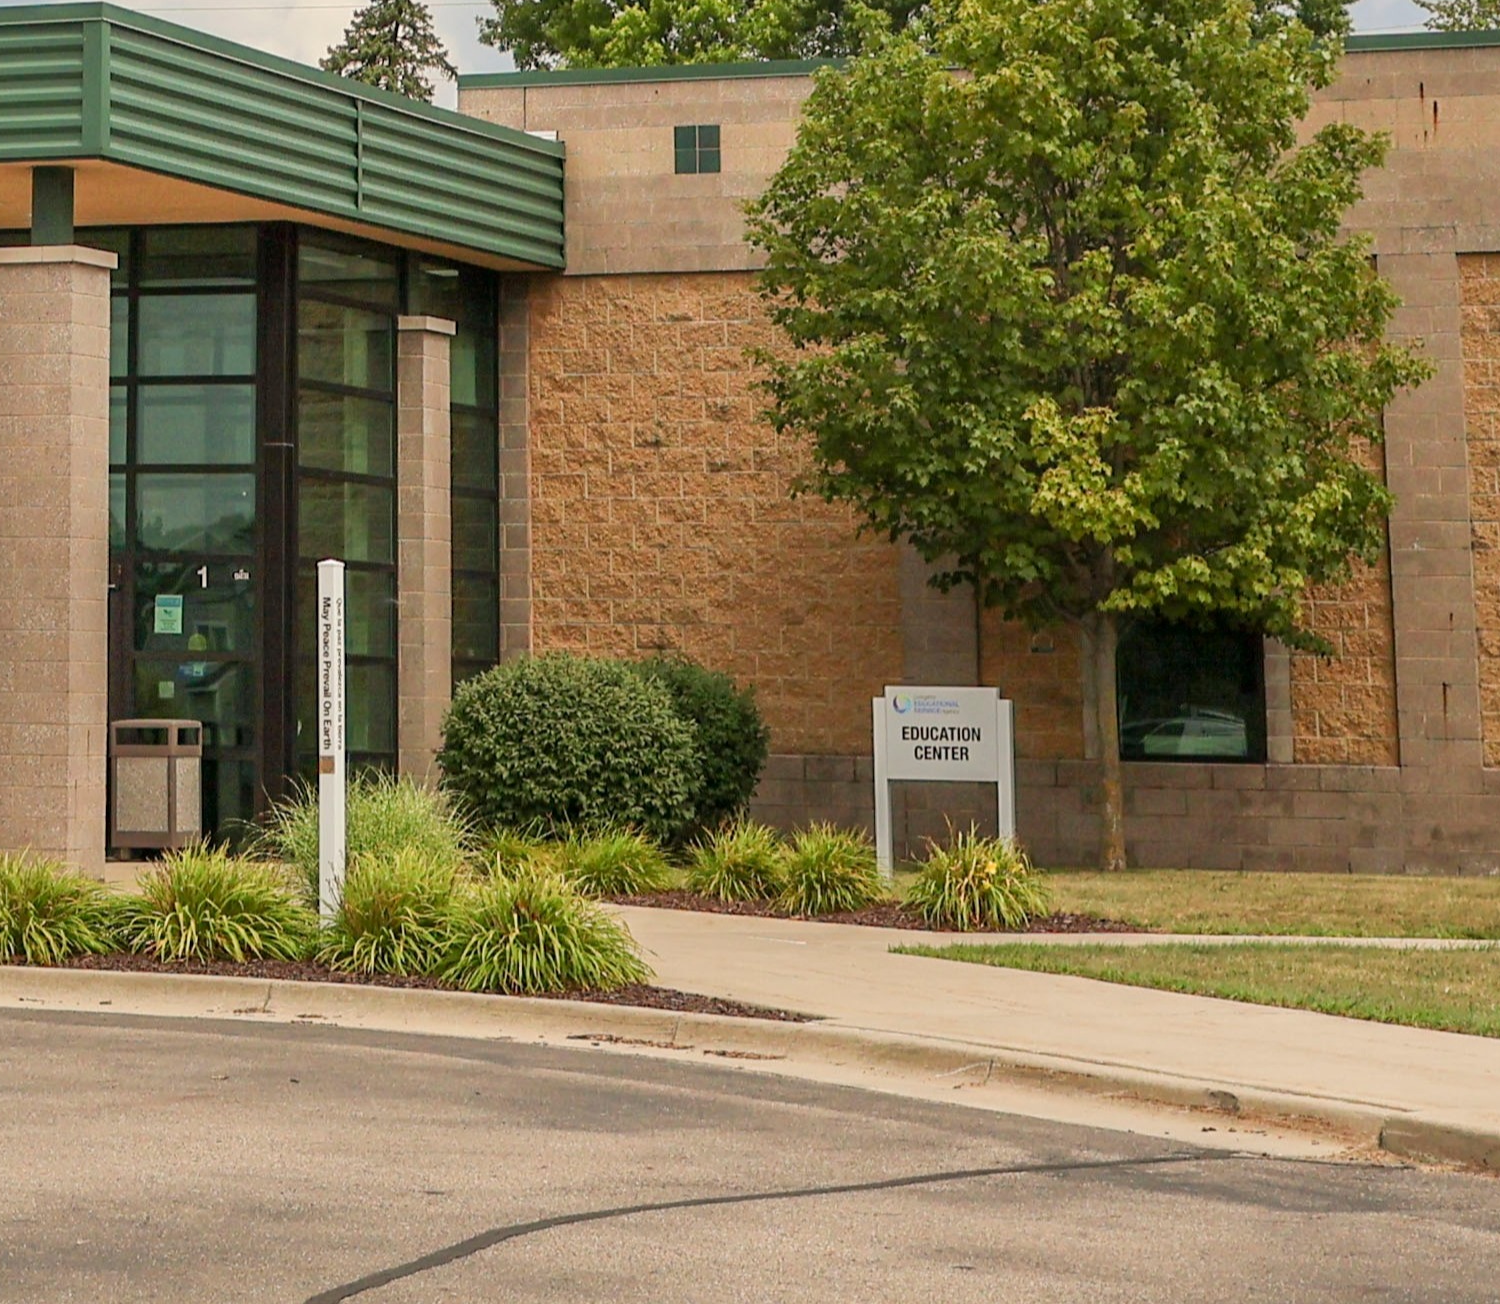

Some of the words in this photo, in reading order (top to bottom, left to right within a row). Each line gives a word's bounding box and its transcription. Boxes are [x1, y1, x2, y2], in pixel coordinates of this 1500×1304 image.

[197, 565, 208, 588] 1
[321, 596, 331, 620] May
[323, 623, 331, 658] Peace
[323, 660, 332, 697] Prevail
[323, 700, 332, 716] On
[323, 720, 332, 750] Earth
[902, 726, 981, 742] EDUCATION
[914, 746, 969, 761] CENTER
